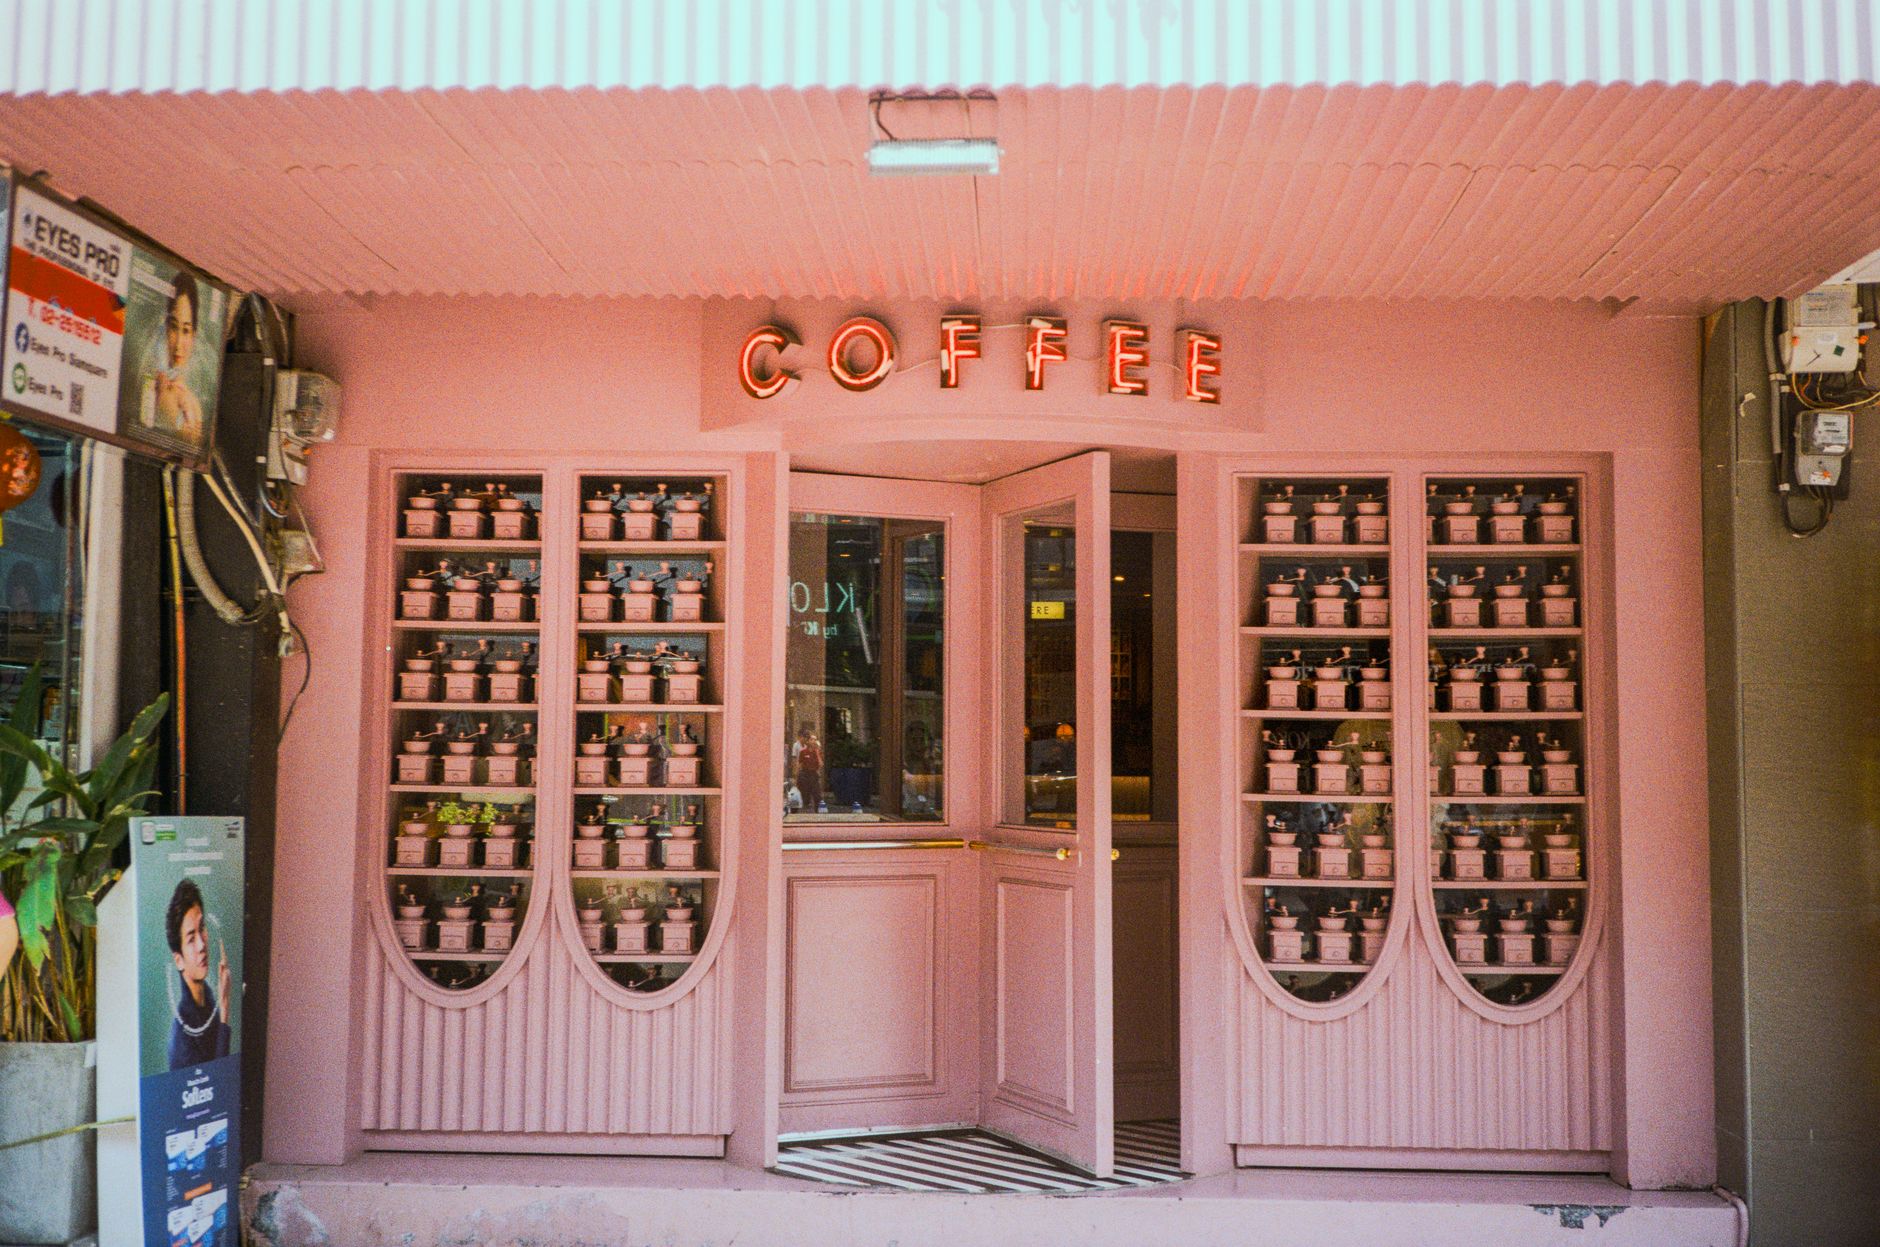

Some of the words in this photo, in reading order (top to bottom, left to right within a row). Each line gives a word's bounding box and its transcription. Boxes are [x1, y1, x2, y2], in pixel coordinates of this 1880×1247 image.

[35, 215, 81, 259] EYES
[85, 241, 120, 278] PRO
[738, 313, 1222, 404] COFFEE
